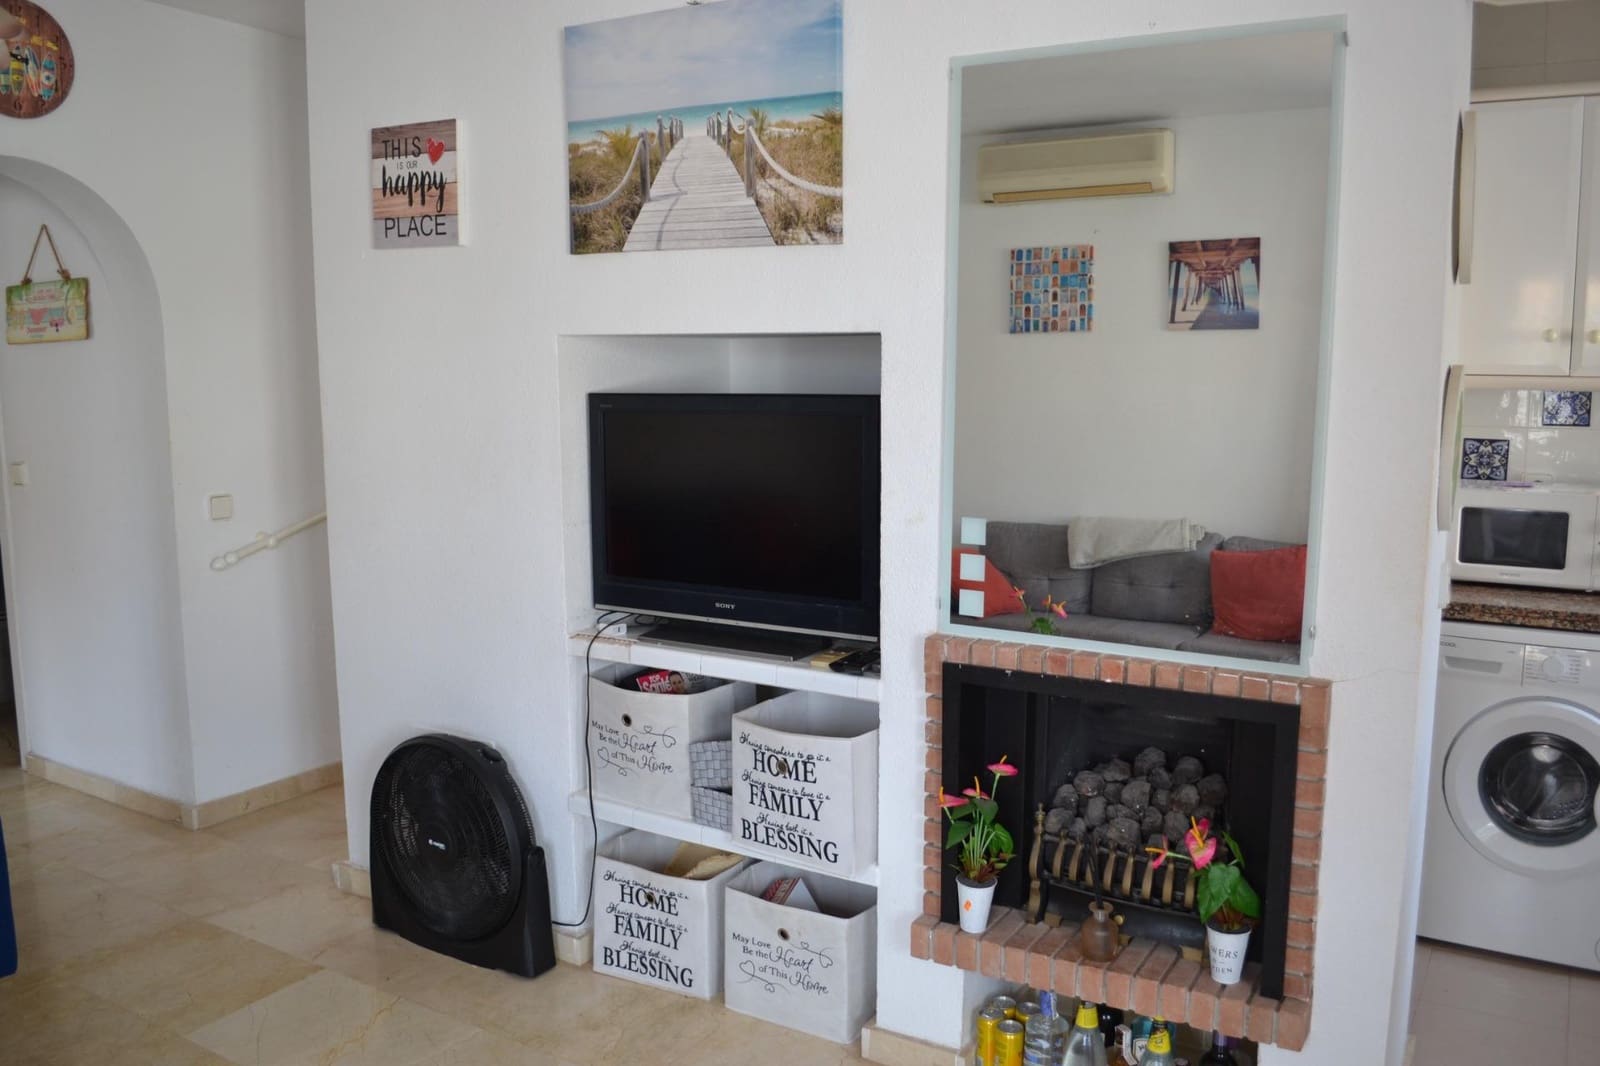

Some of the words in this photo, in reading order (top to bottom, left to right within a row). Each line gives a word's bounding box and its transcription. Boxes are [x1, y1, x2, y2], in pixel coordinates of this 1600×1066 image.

[382, 136, 421, 160] THIS
[397, 162, 403, 170] IS
[406, 161, 418, 170] OUR
[382, 165, 447, 213] happy
[384, 214, 447, 239] PLACE
[715, 602, 736, 610] SONY
[599, 732, 608, 743] Be
[618, 732, 657, 753] Heart
[605, 726, 620, 736] Love
[611, 751, 618, 760] of
[619, 752, 636, 764] This
[637, 754, 674, 774] Home
[753, 748, 817, 784] HOME
[749, 782, 824, 822] FAMILY
[741, 817, 839, 864] BLESSING
[620, 883, 679, 917] HOME
[614, 914, 682, 951] FAMILY
[732, 932, 749, 945] May
[752, 937, 771, 949] Love
[603, 946, 694, 988] BLESSING
[743, 945, 753, 955] Be
[755, 949, 768, 959] the
[769, 946, 814, 973] Heart
[758, 965, 767, 973] of
[769, 966, 788, 979] This
[789, 971, 829, 996] Home
